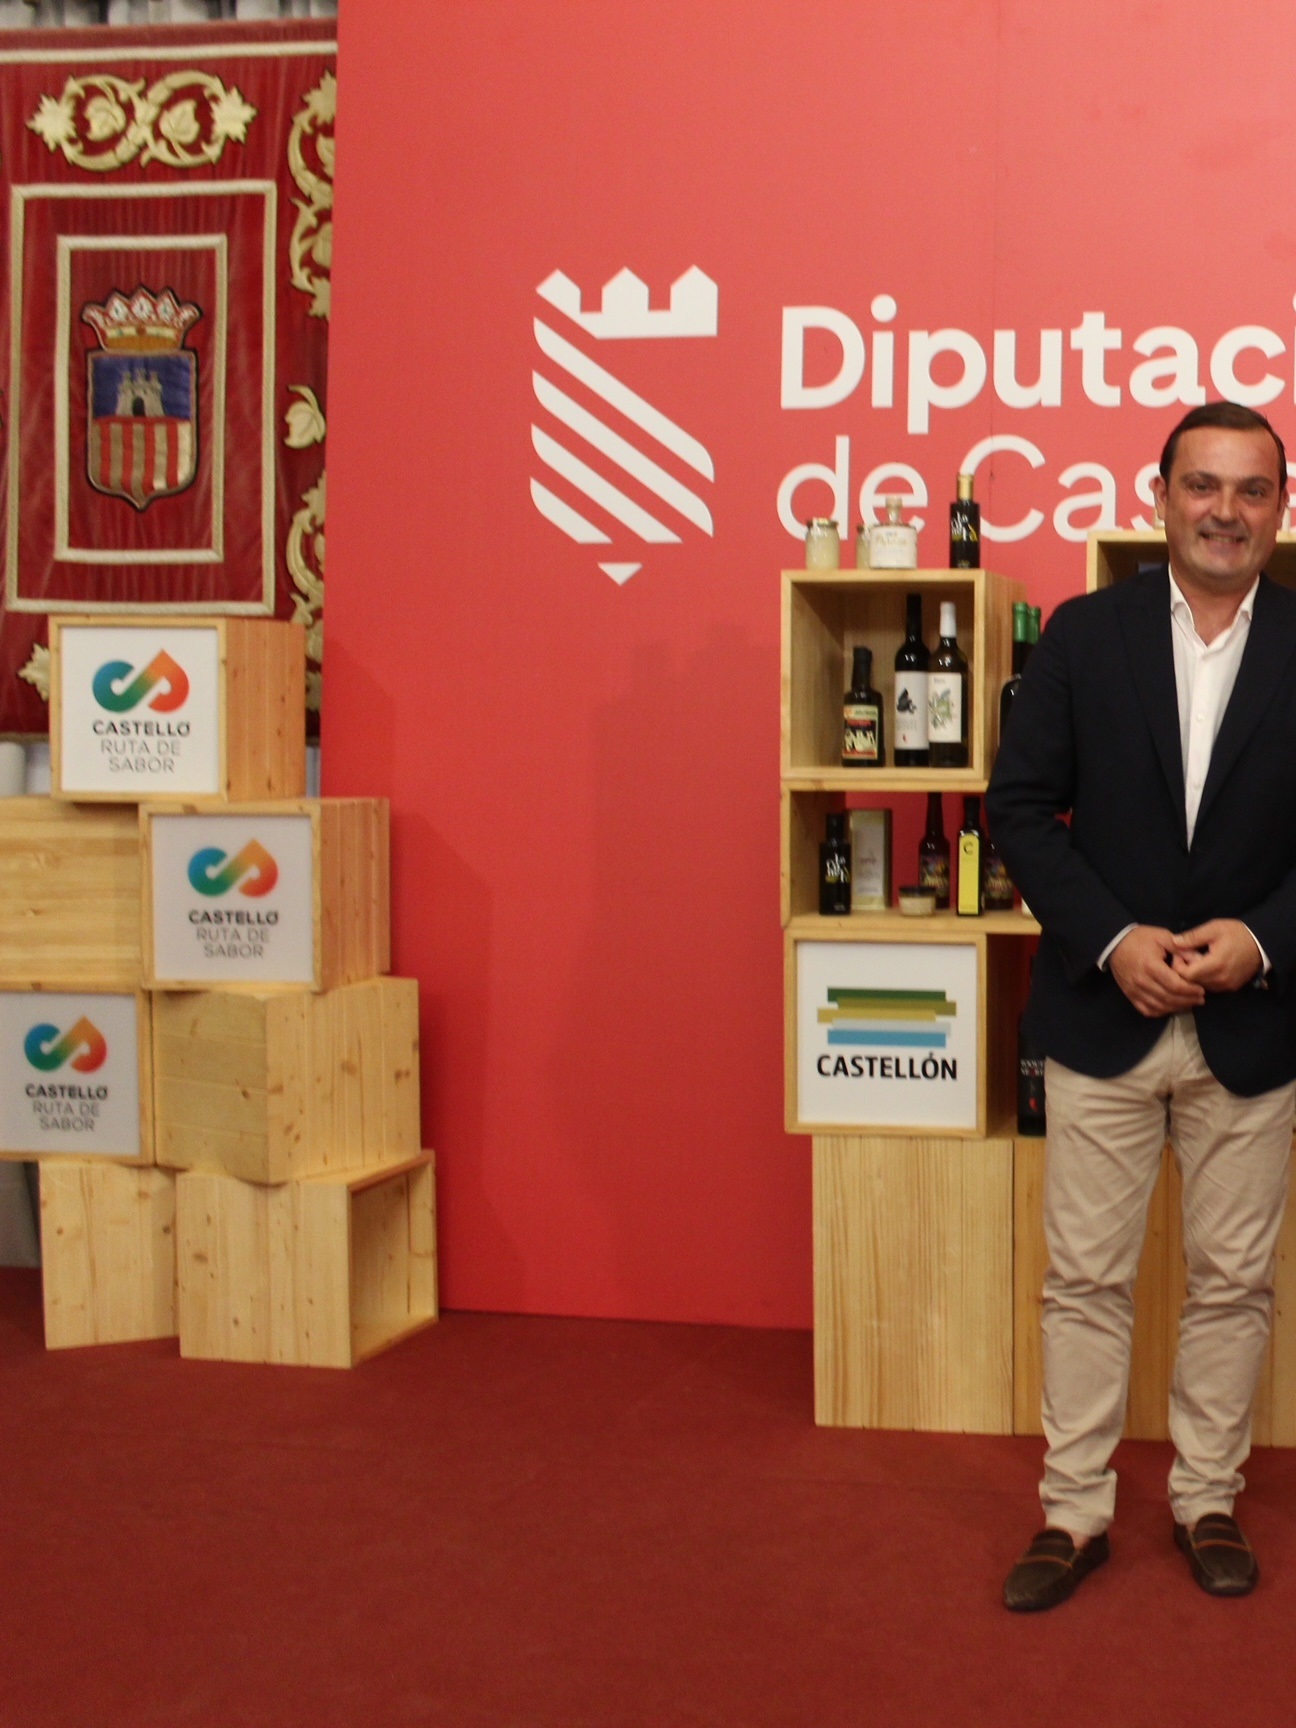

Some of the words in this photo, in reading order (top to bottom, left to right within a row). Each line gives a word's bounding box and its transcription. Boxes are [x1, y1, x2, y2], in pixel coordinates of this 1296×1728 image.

[777, 436, 929, 544] de
[101, 739, 150, 754] RUTA
[157, 740, 181, 756] DE
[109, 756, 175, 773] SABOR
[196, 926, 241, 941] RUTA
[247, 927, 270, 943] DE
[203, 943, 264, 959] SABOR
[817, 1053, 957, 1080] CASTELLÓN
[33, 1100, 74, 1115] RUTA
[79, 1101, 100, 1118] DE
[39, 1115, 96, 1132] SABOR
